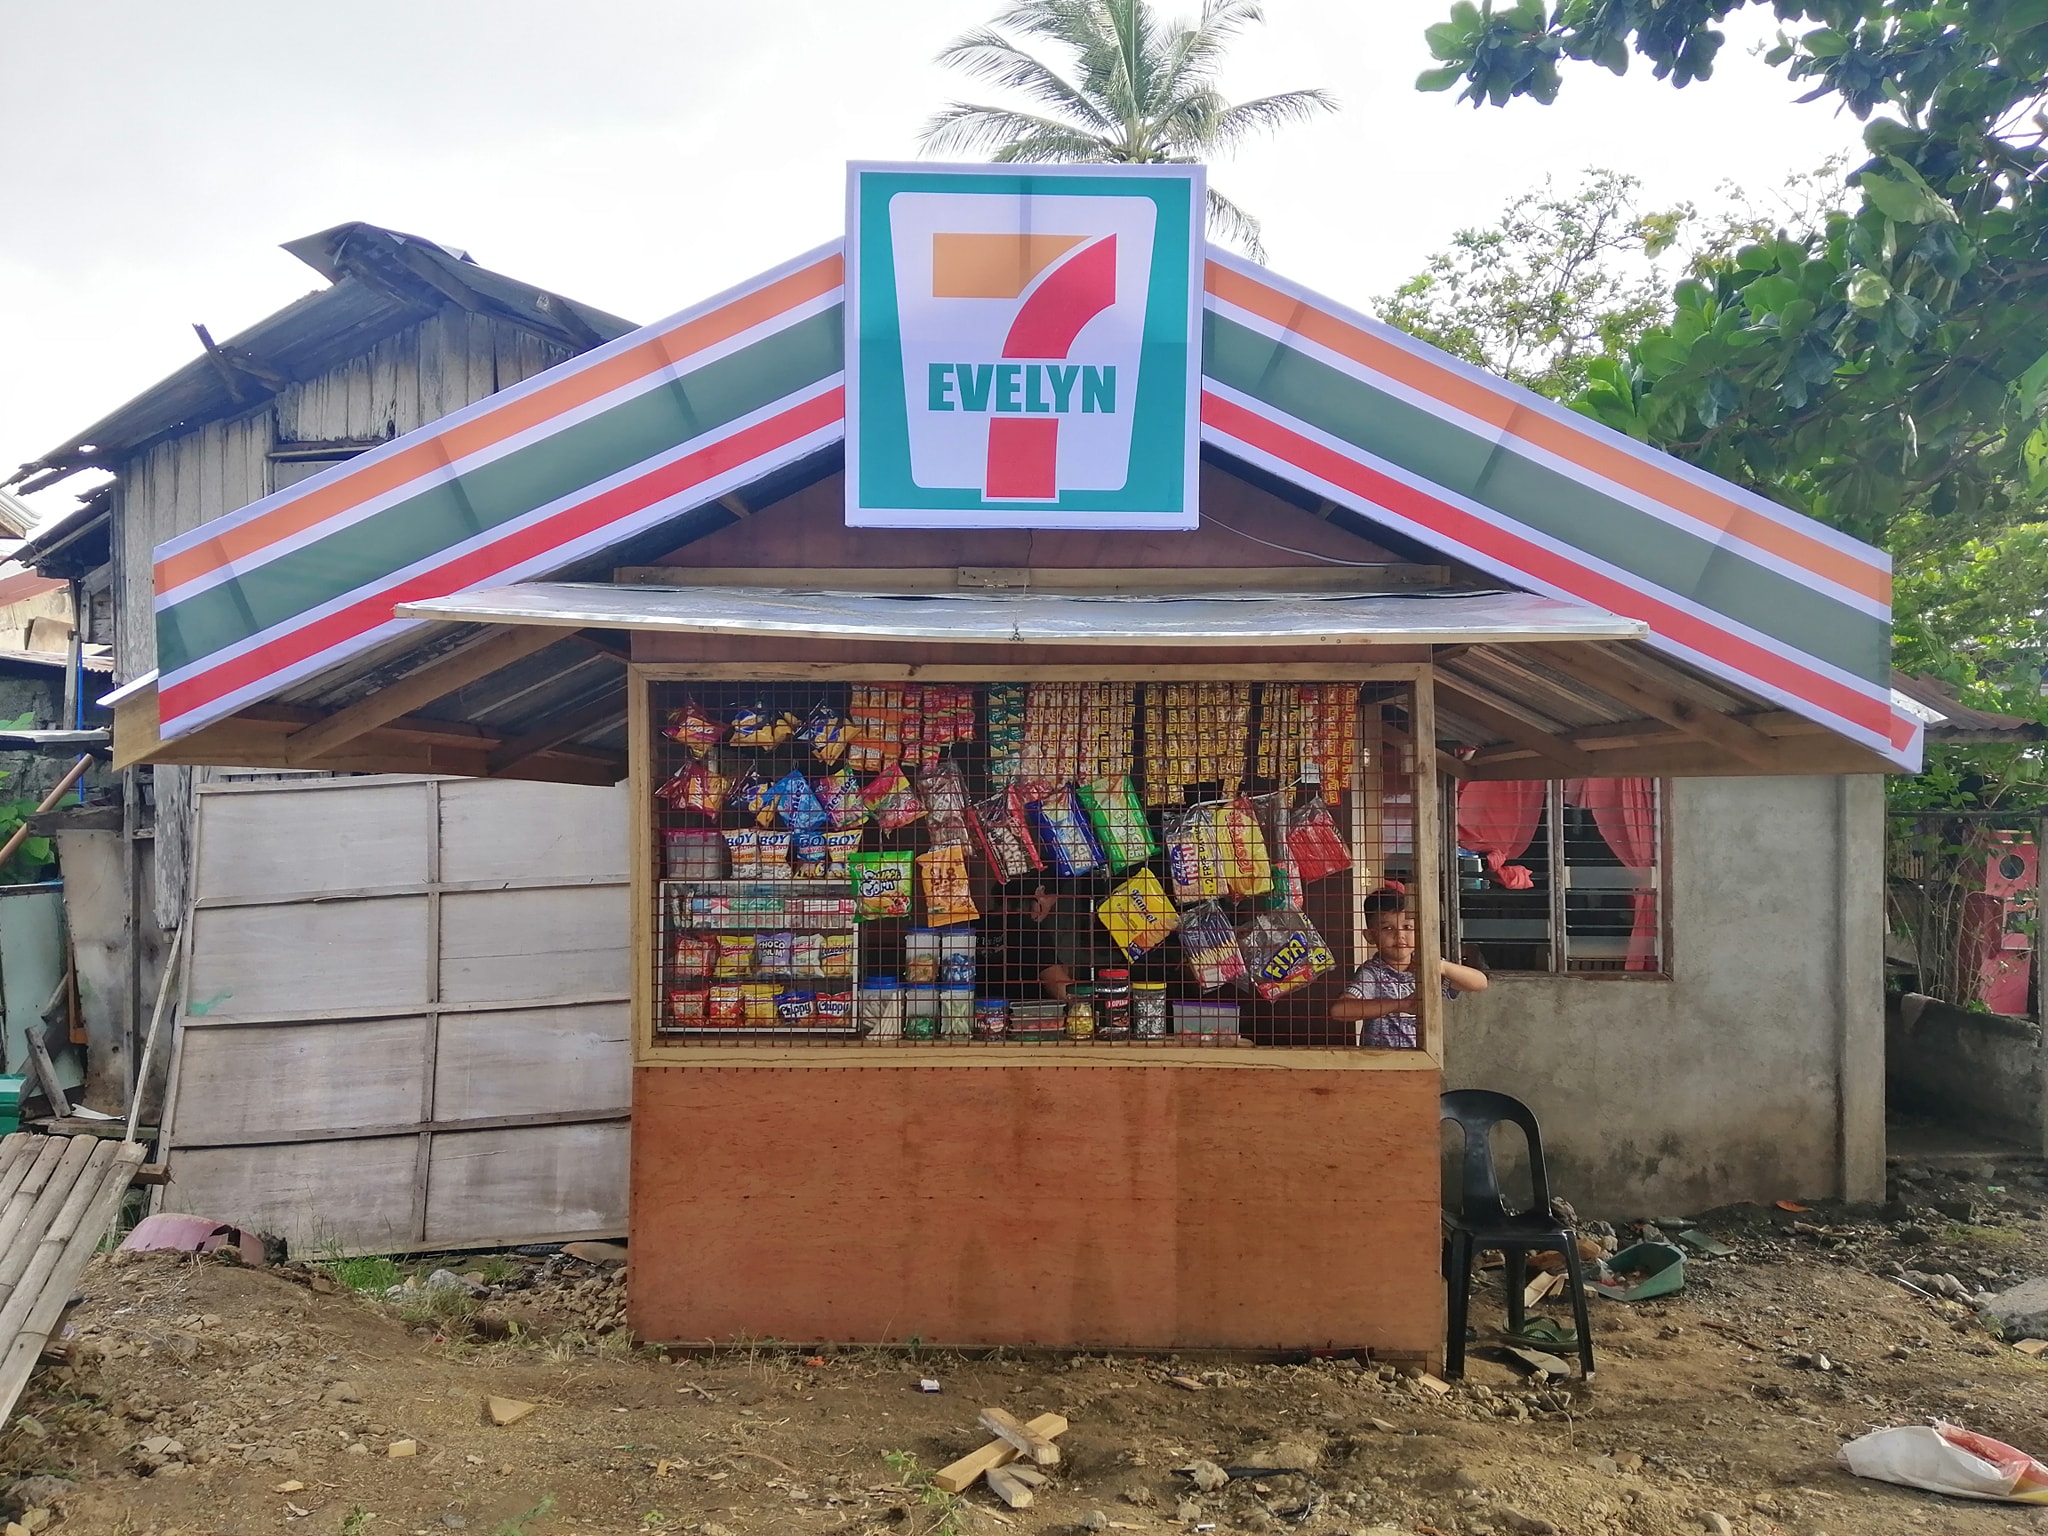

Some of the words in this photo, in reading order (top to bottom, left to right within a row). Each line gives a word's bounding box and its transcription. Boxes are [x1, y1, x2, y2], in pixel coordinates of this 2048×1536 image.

[928, 362, 1117, 414] EVELYN
[726, 833, 754, 847] BOY
[760, 833, 790, 846] BOY
[800, 835, 826, 848] BO
[828, 833, 860, 847] BOY
[860, 880, 894, 896] Corn
[1131, 889, 1158, 923] Hanel
[759, 940, 785, 949] CHOCO
[1265, 938, 1307, 979] FITA
